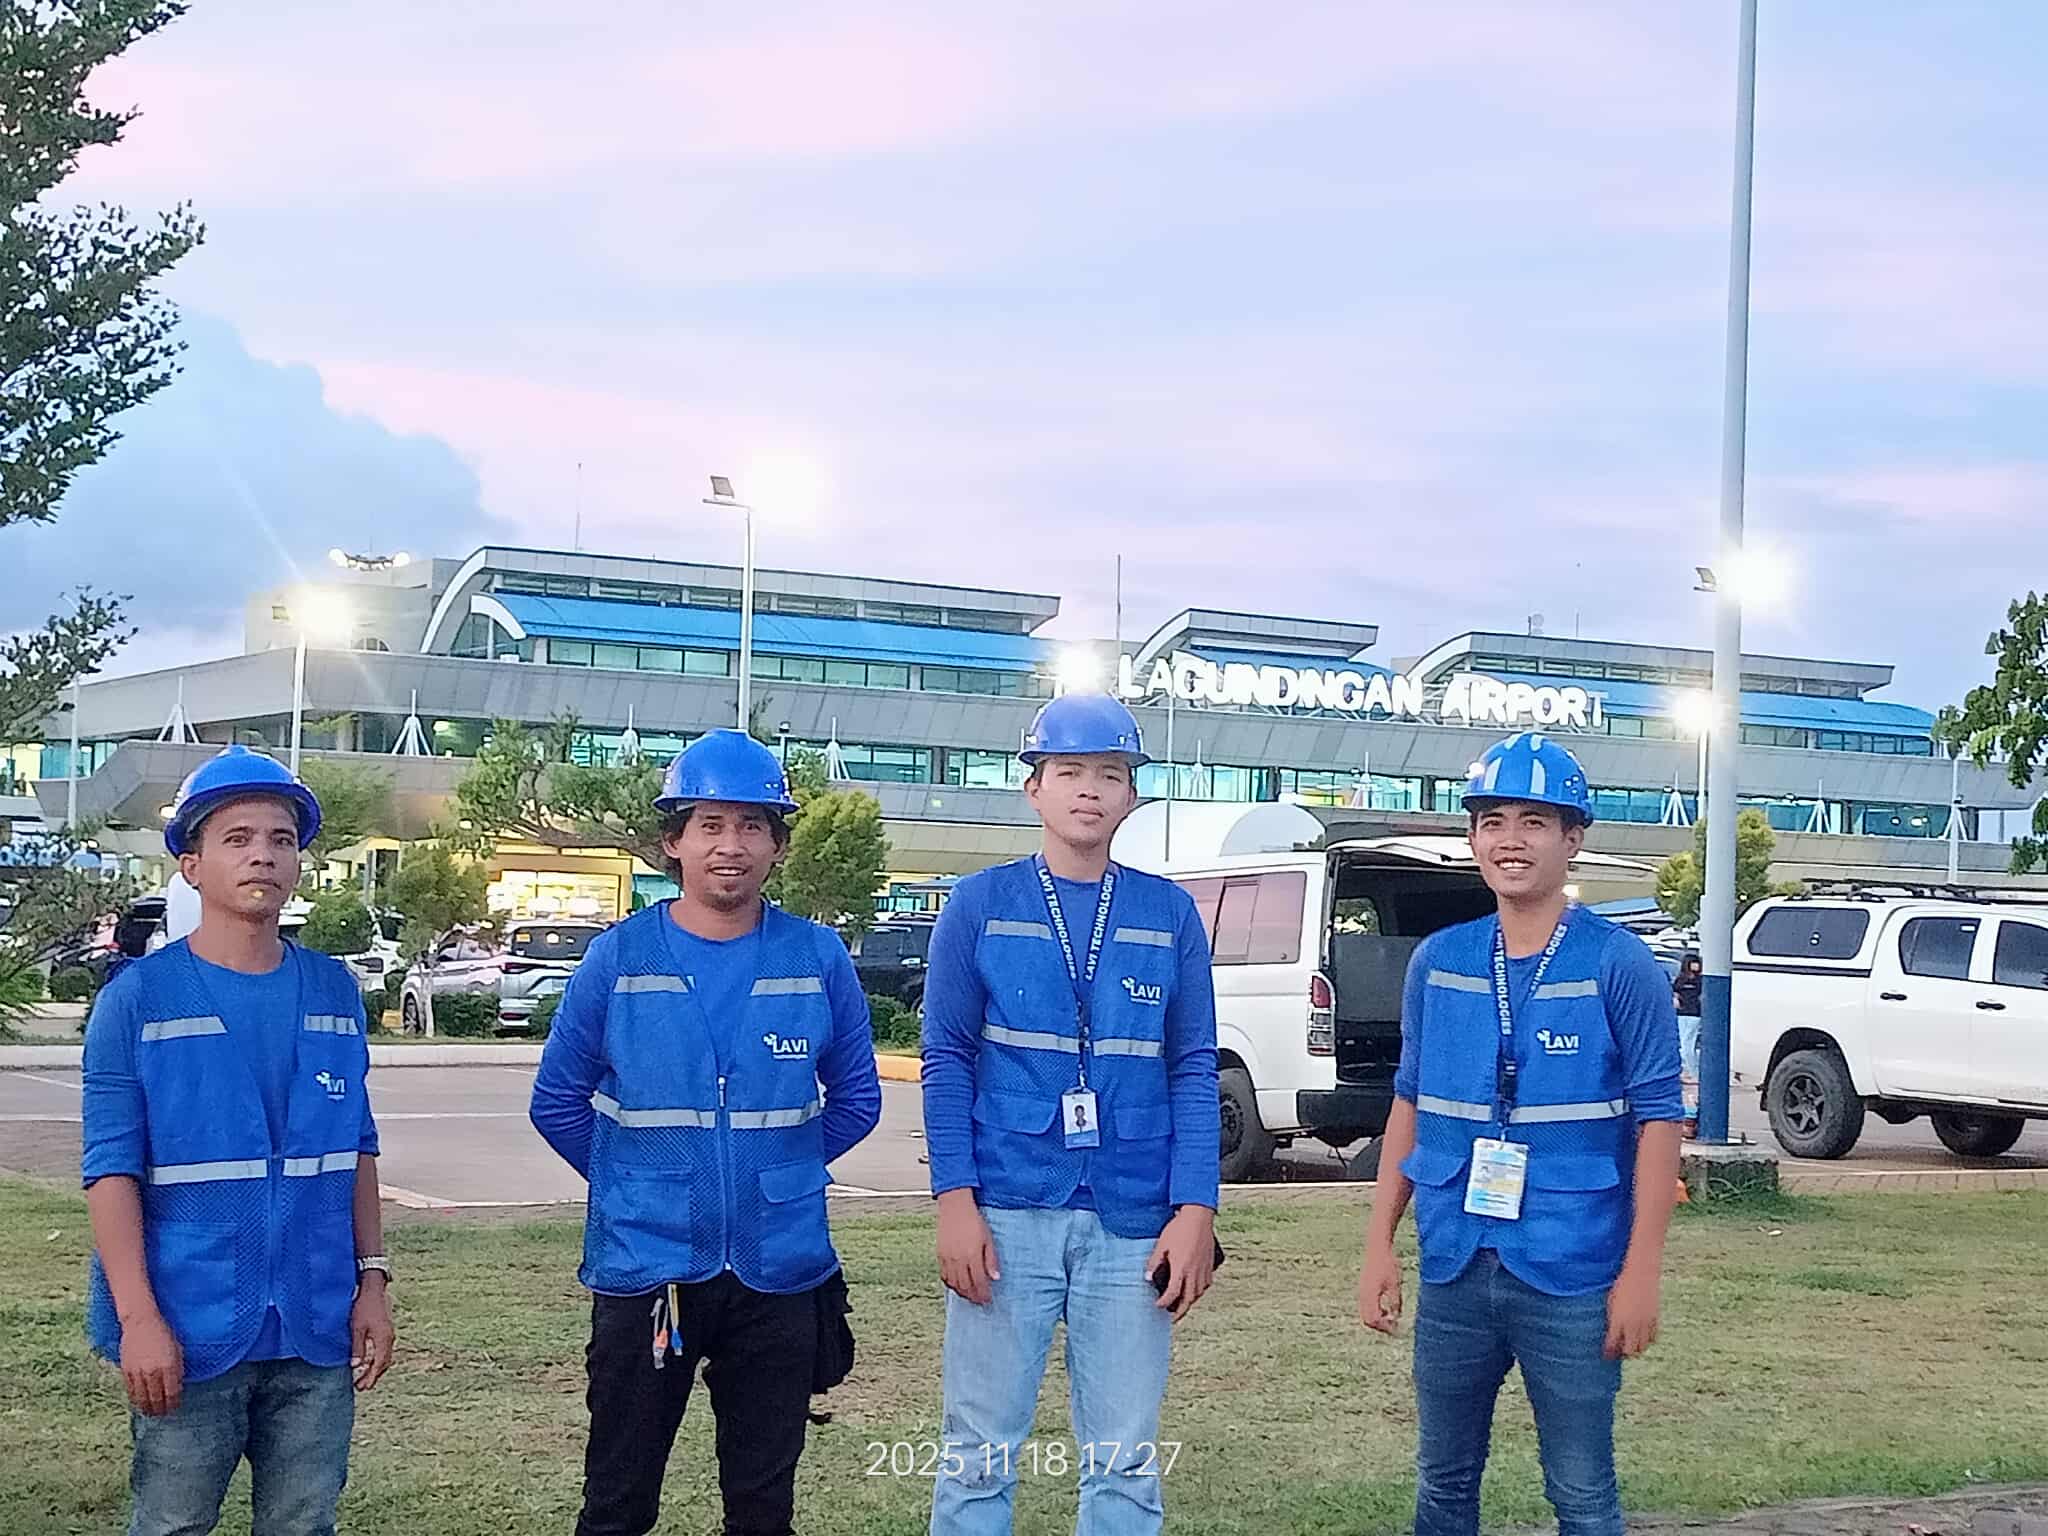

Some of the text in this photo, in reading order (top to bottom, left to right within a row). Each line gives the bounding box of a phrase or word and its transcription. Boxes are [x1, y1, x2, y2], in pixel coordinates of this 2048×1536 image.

[1441, 673, 1608, 728] AIRPORT
[1038, 868, 1055, 892] LAVI
[1085, 953, 1098, 981] LAVI
[1130, 983, 1161, 999] LAVI
[773, 1038, 808, 1053] LAVI
[1545, 1034, 1579, 1049] LAVI
